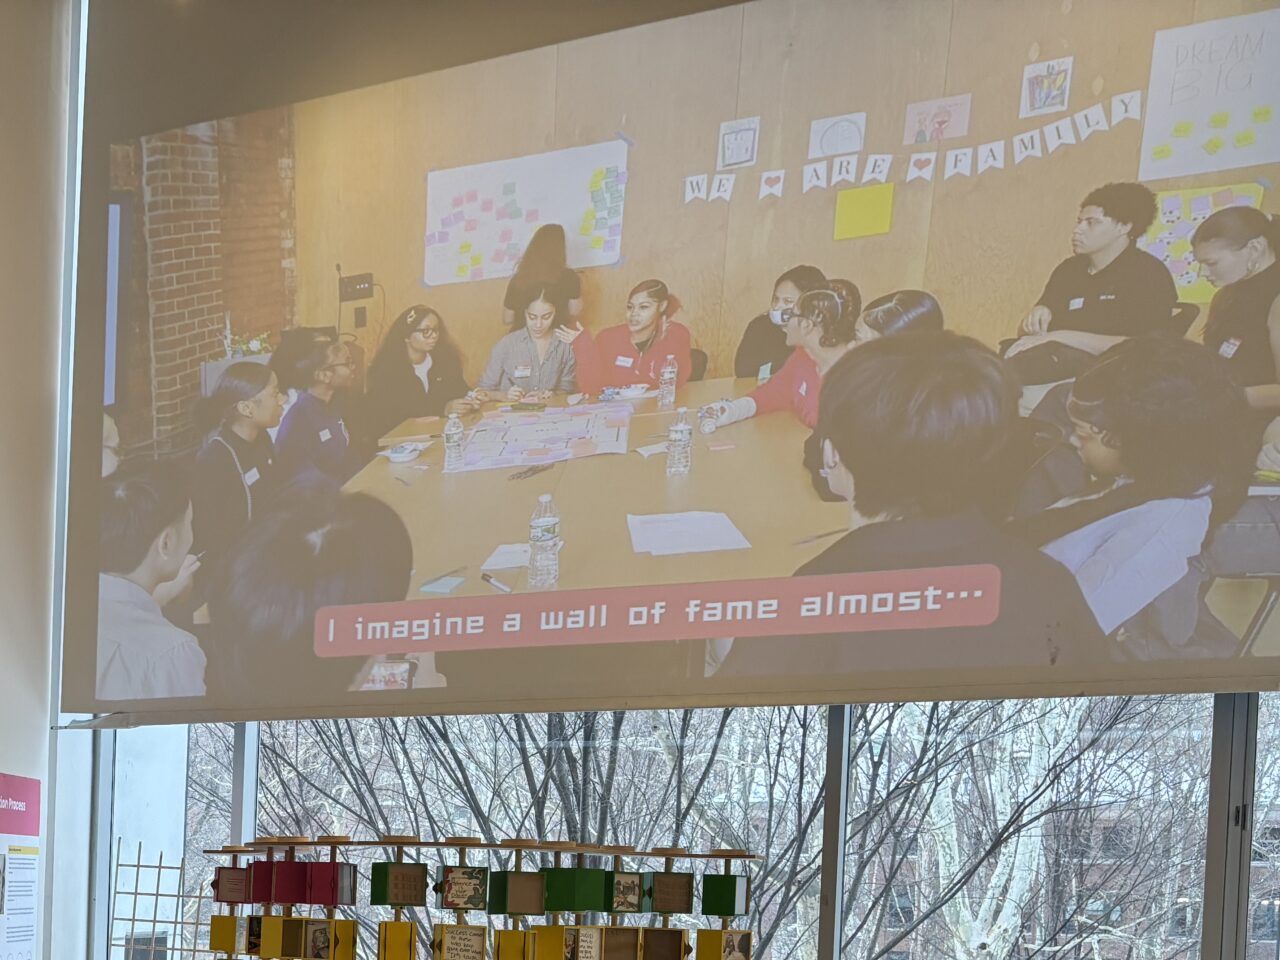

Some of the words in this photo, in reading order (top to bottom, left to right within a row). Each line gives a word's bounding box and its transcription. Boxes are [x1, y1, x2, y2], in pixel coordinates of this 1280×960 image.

[1176, 32, 1265, 65] DREAM
[690, 180, 728, 194] WE
[810, 159, 885, 184] ARE
[953, 98, 1134, 168] FAMILY
[356, 613, 484, 640] imagine
[503, 613, 521, 632] a
[540, 605, 607, 629] wall
[629, 602, 665, 625] of
[685, 600, 778, 621] fame
[9, 798, 26, 811] Process
